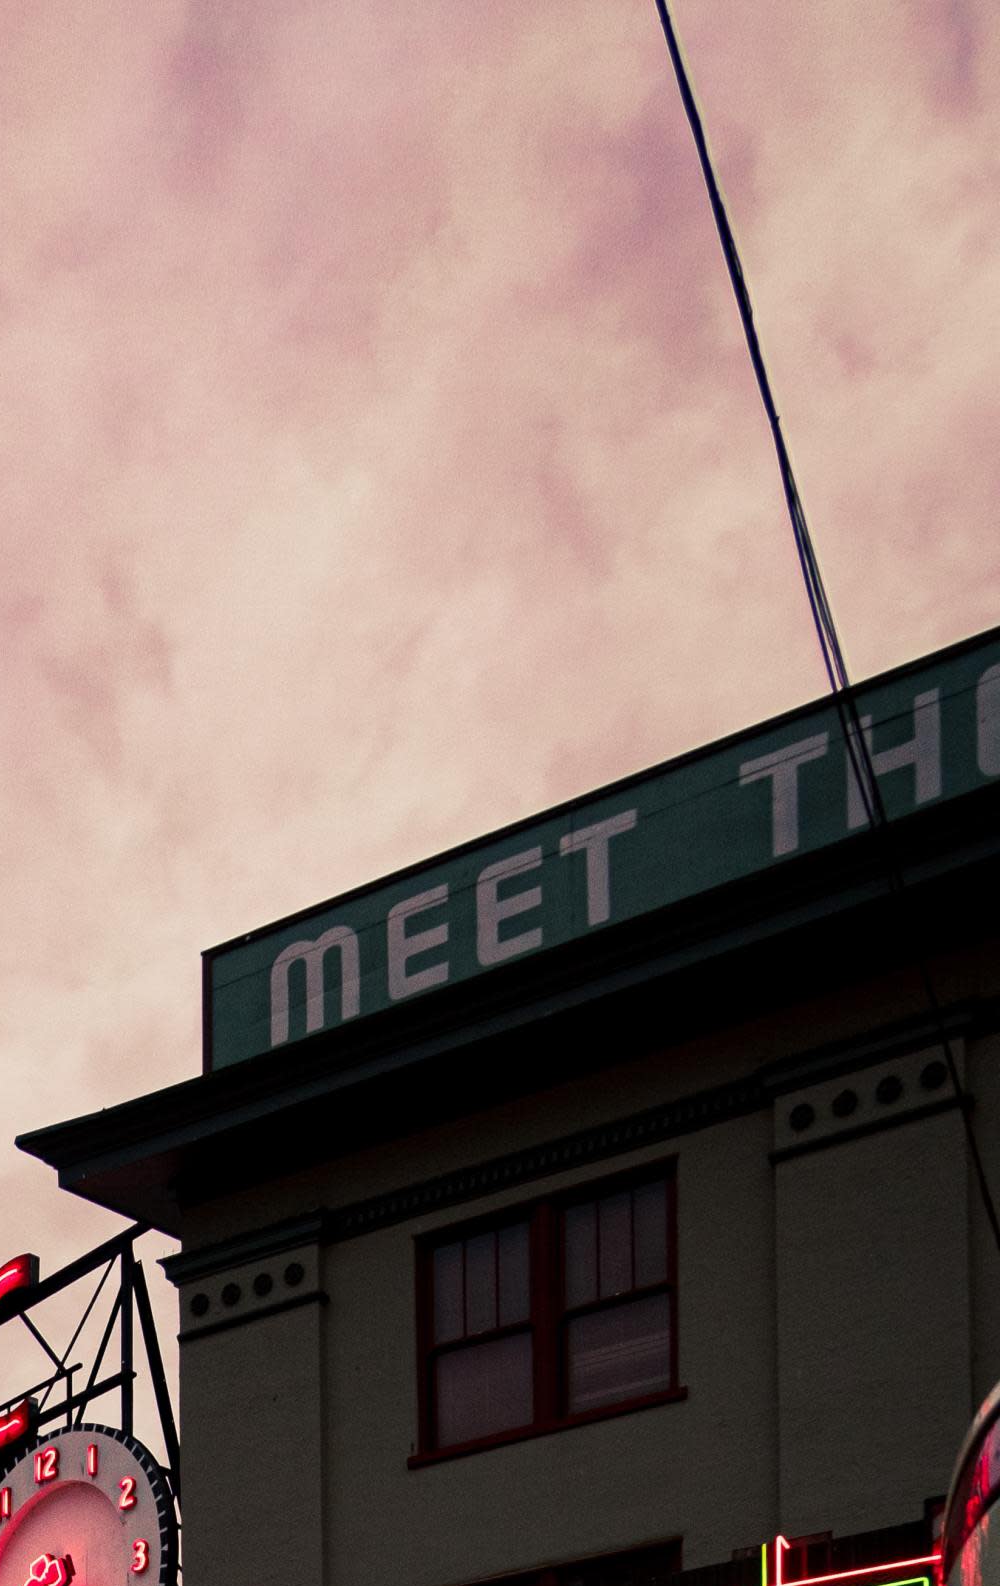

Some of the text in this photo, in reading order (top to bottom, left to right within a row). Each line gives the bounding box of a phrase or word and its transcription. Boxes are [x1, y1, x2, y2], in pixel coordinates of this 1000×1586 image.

[269, 807, 638, 1049] MEET
[34, 1446, 59, 1484] 12
[87, 1443, 98, 1477] 1
[119, 1476, 137, 1510] 2
[131, 1538, 150, 1574] 3
